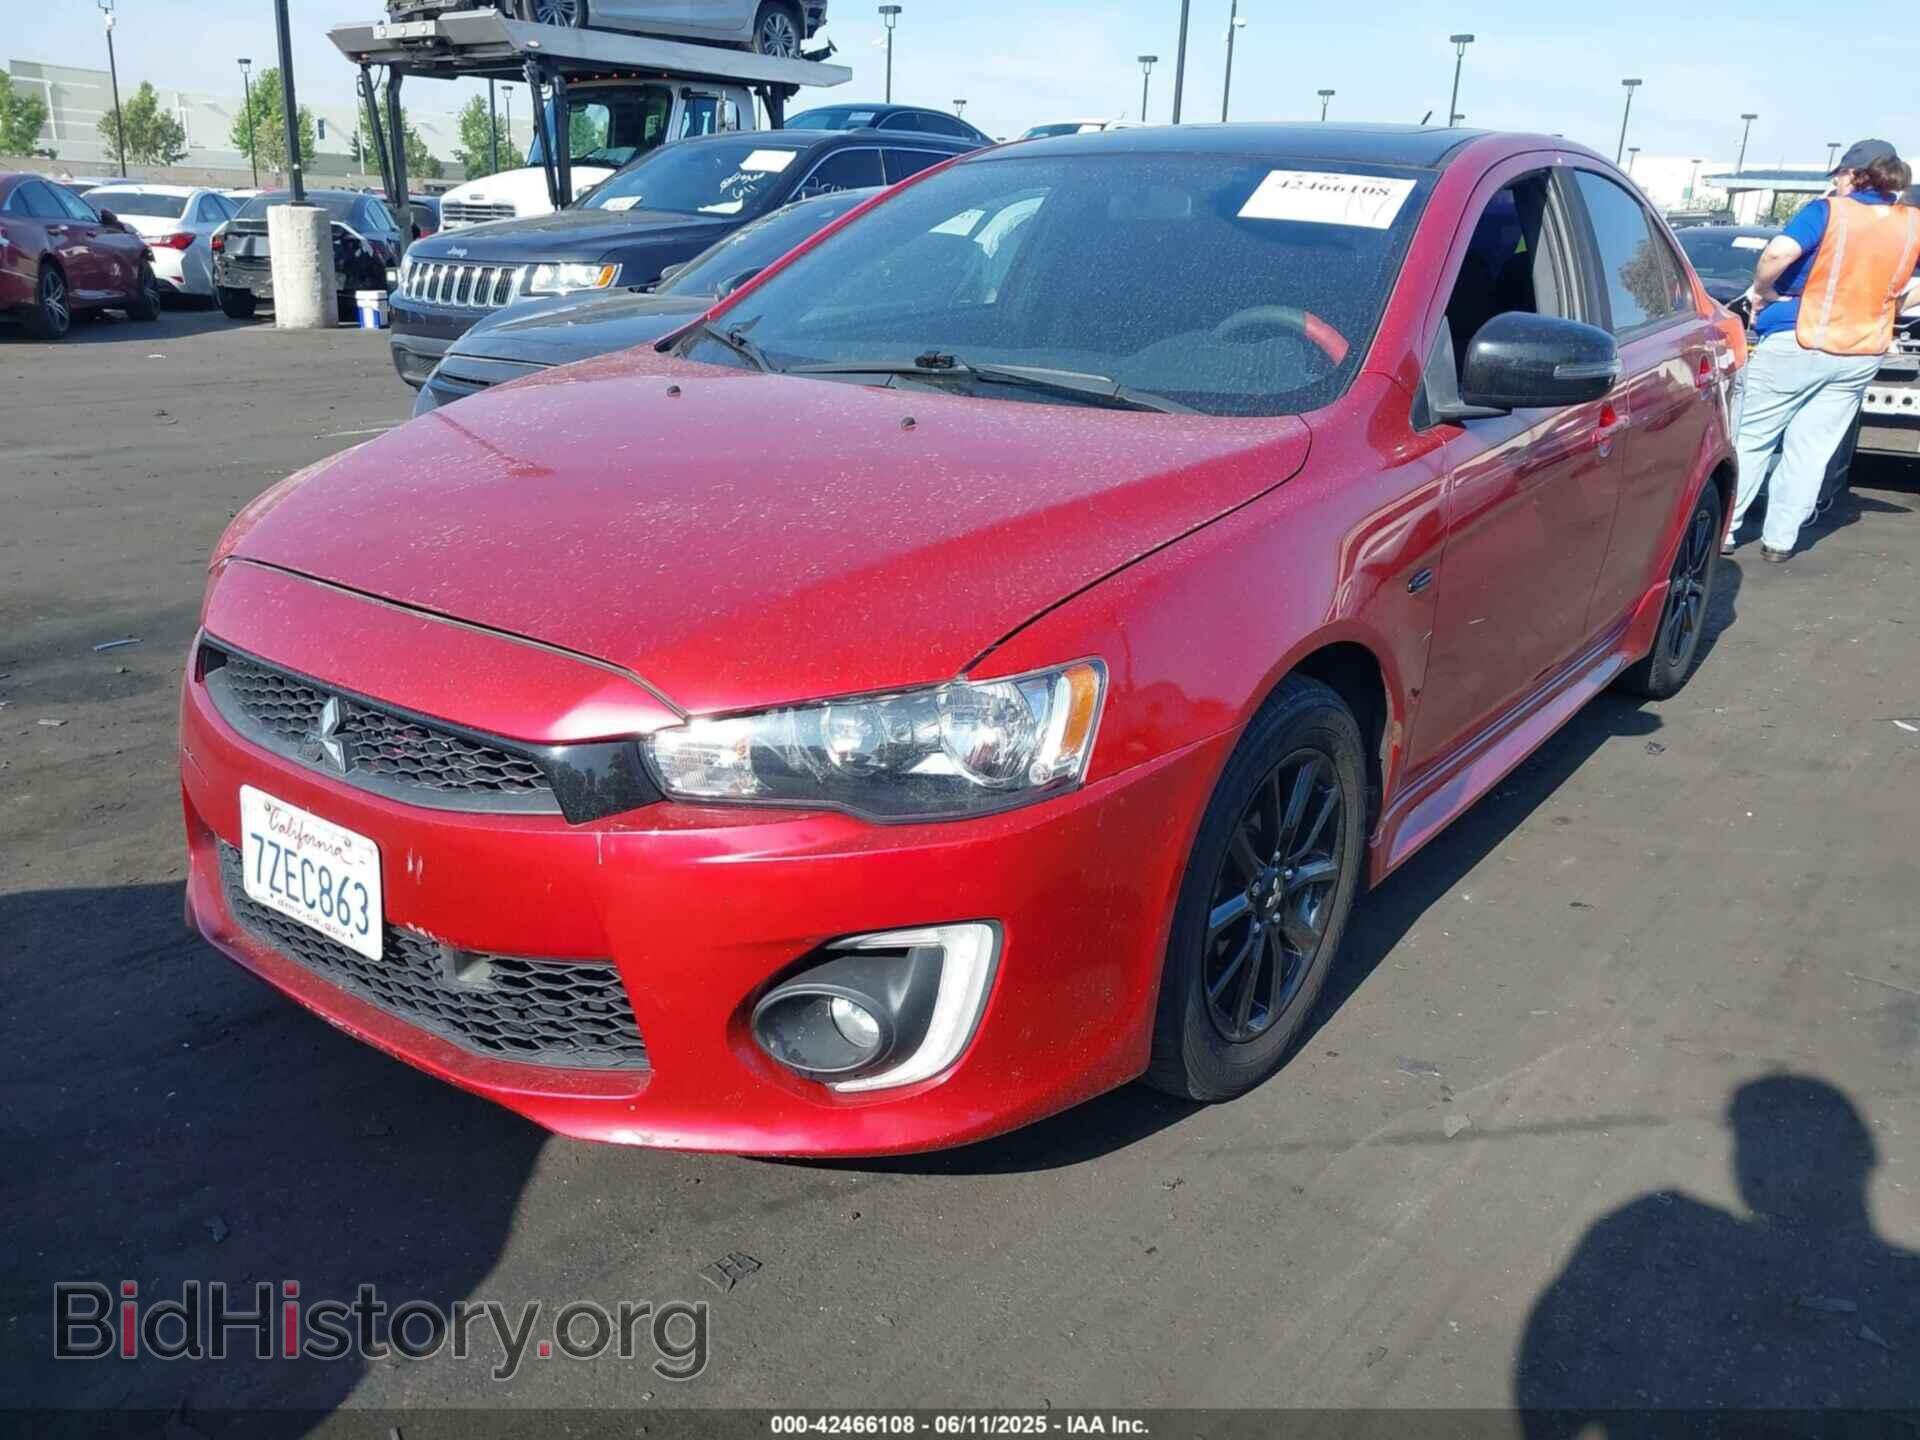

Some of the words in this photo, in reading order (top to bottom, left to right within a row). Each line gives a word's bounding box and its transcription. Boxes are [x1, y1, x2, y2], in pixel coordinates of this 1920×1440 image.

[1275, 179, 1392, 197] 42466108
[267, 806, 353, 866] California
[251, 832, 369, 935] 7ZEC863
